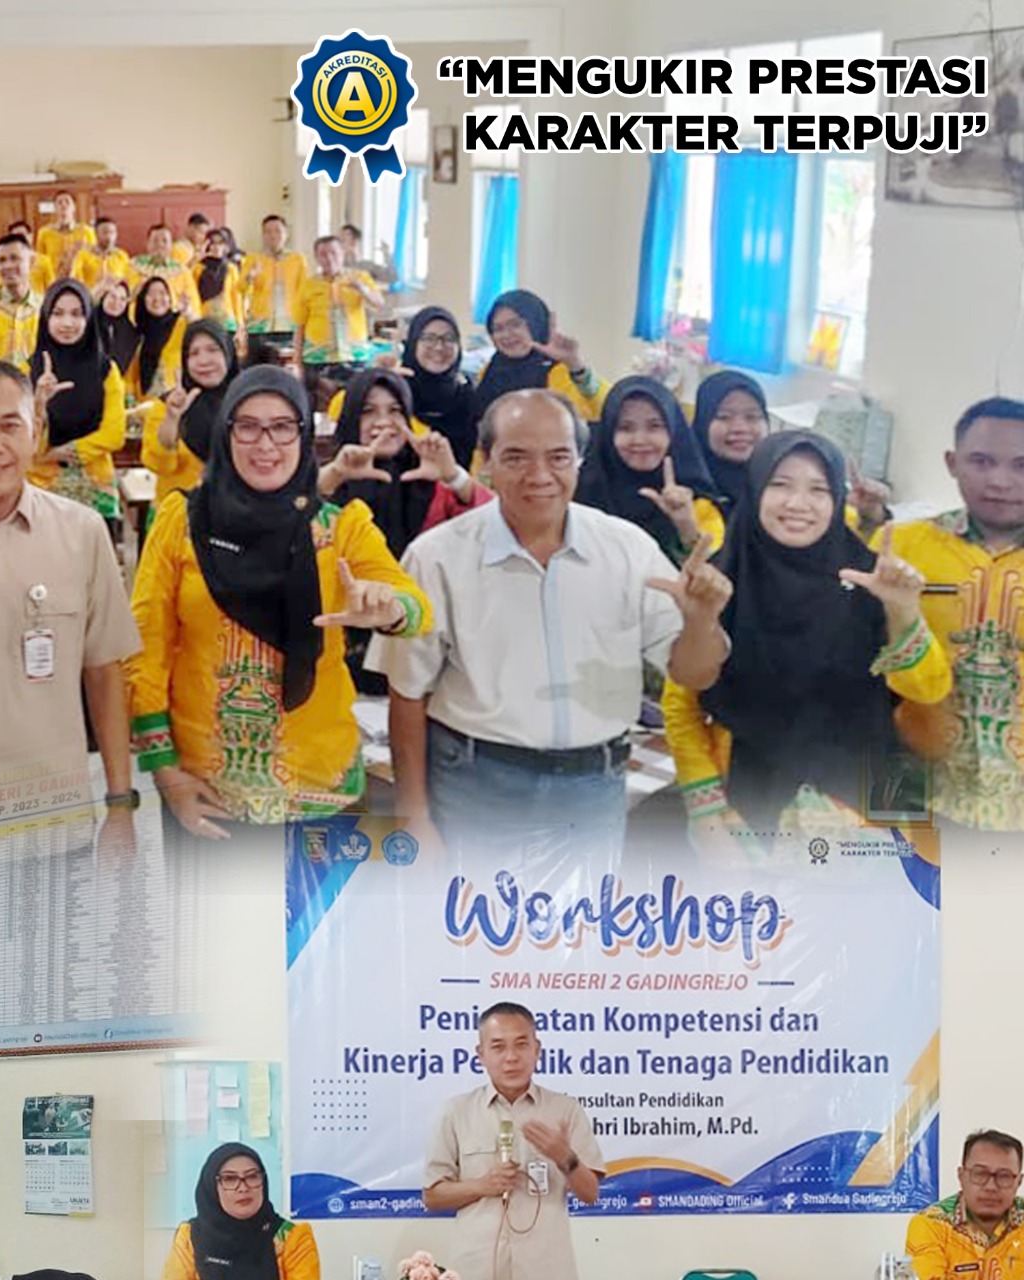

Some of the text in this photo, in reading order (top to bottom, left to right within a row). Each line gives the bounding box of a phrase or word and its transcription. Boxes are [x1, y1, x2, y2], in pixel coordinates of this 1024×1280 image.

[26, 785, 35, 796] 2
[12, 799, 39, 813] 2023
[51, 791, 81, 805] 2024
[445, 871, 789, 966] Workshop
[490, 972, 748, 991] SMA NEGERI 2 GADINGREJO
[420, 1005, 818, 1038] Peniatan Kompetensi dan
[344, 1047, 889, 1080] Kinerja Pedik dan Tenaga Pendidikan
[576, 1093, 724, 1108] nsultan Pendidikan
[592, 1117, 758, 1137] hri Ibrahim, M.Pd.
